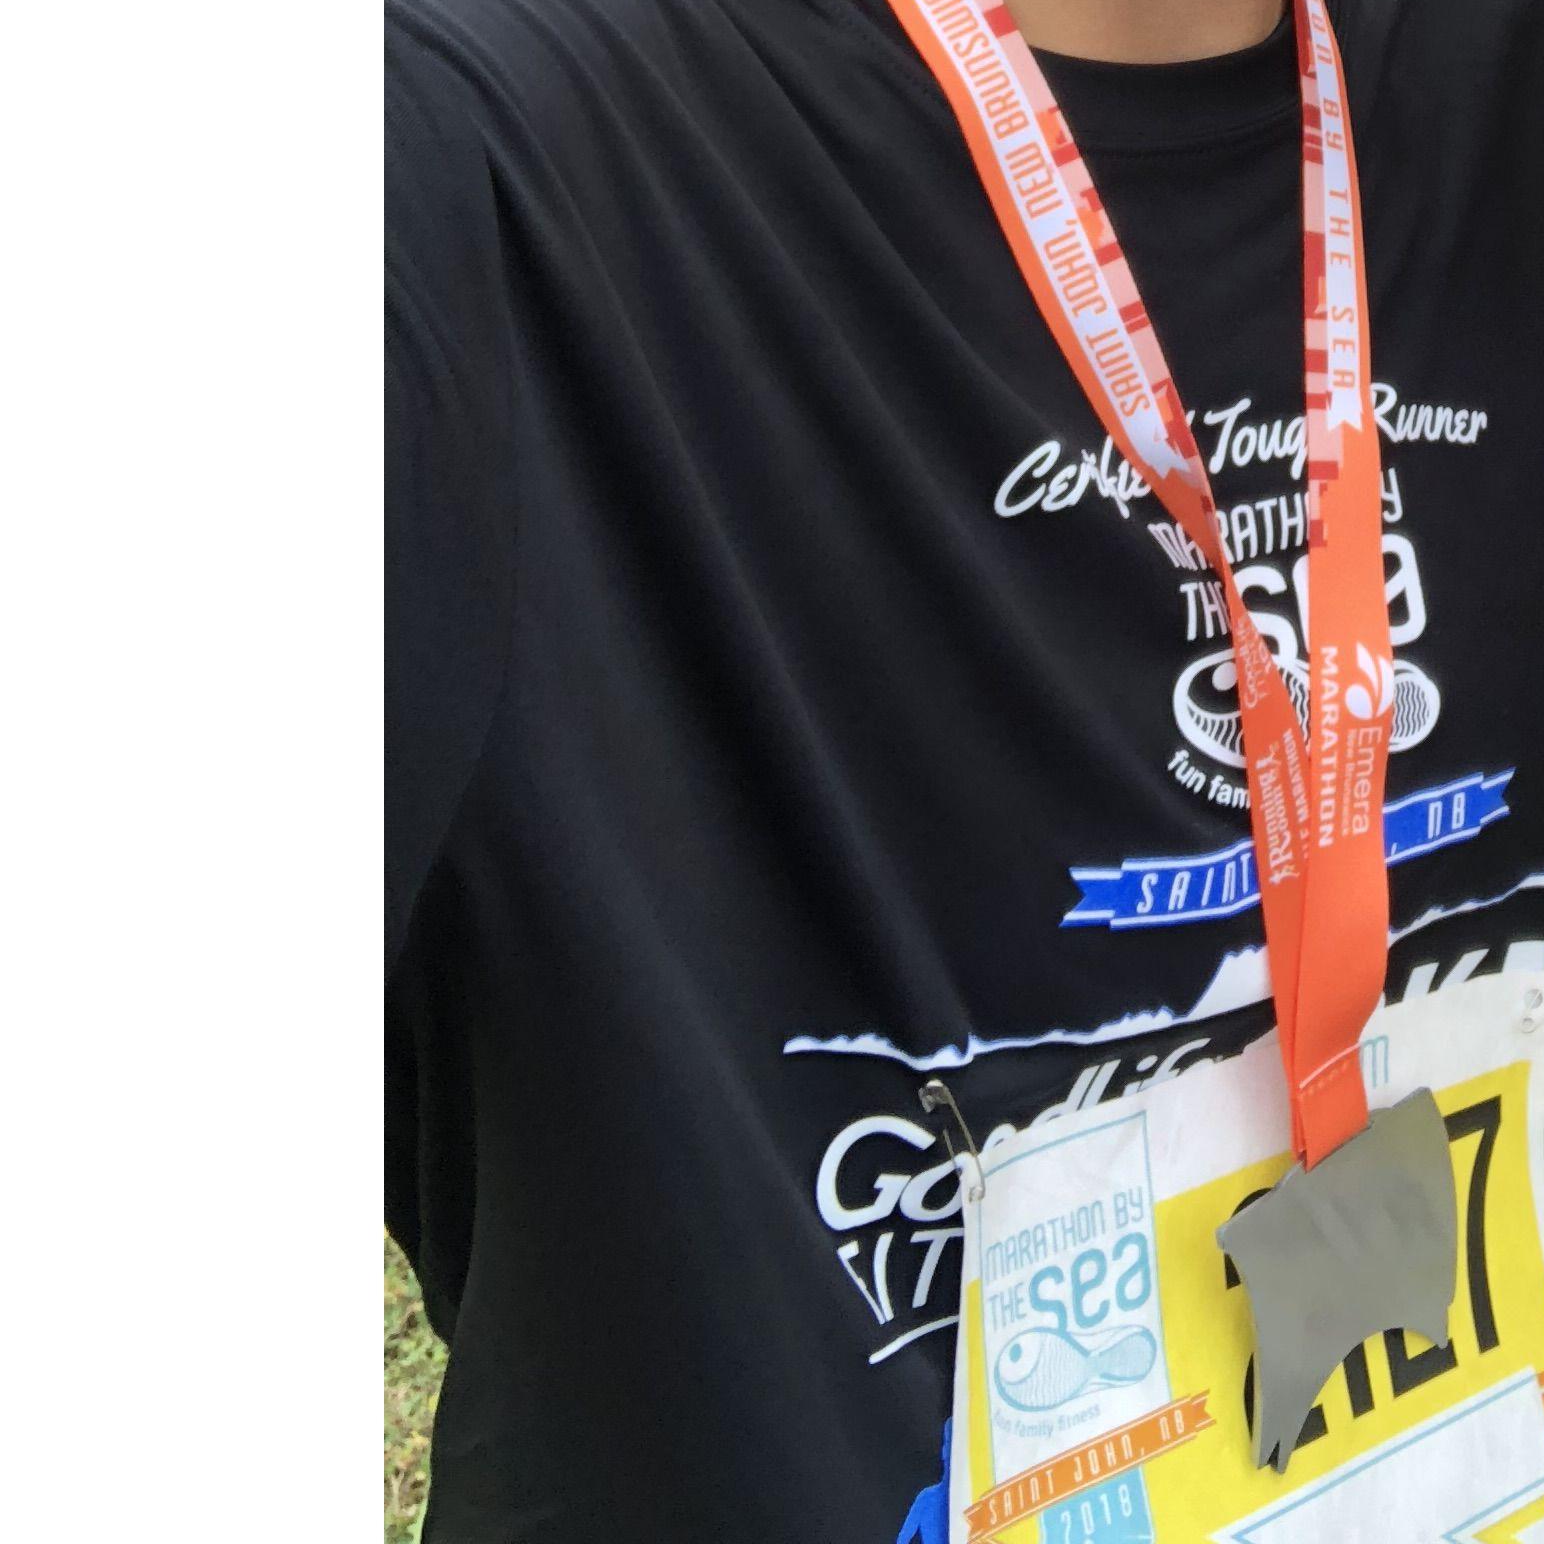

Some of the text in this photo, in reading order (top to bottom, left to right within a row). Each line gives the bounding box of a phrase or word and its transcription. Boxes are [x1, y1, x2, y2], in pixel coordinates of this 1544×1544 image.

[1001, 140, 1059, 220] NEW
[1042, 219, 1107, 317] JOHN,
[1322, 97, 1356, 391] BY THE SEA
[1084, 315, 1151, 417] SAINT
[1203, 398, 1308, 480] Toug
[1369, 382, 1488, 446] Runner
[1166, 748, 1250, 810] fun fam
[1317, 646, 1340, 849] MARATHON
[1352, 725, 1383, 836] Emera
[1426, 791, 1466, 840] NB
[1135, 854, 1259, 916] SAINT
[984, 1199, 1106, 1283] MARATHON
[1113, 1185, 1145, 1228] BY
[987, 1282, 1029, 1333] THE
[988, 1469, 1056, 1525] SAINT
[1159, 1407, 1186, 1443] NB
[1014, 1414, 1055, 1439] family
[1060, 1482, 1134, 1544] 2018
